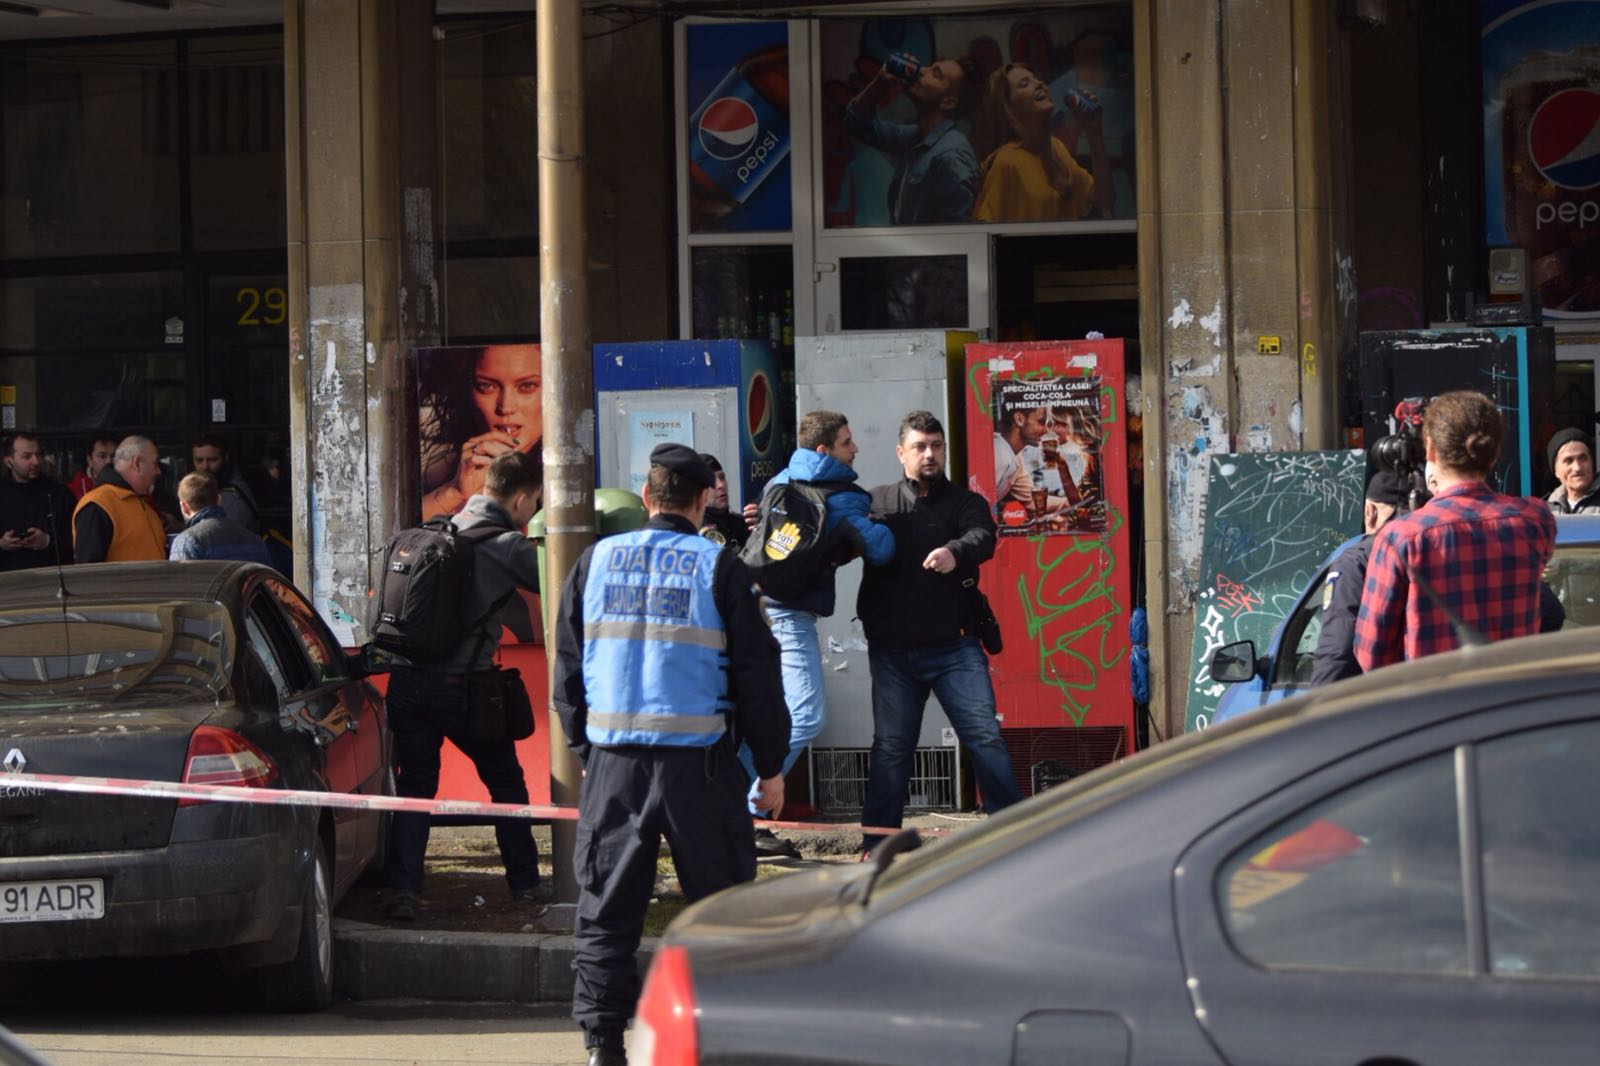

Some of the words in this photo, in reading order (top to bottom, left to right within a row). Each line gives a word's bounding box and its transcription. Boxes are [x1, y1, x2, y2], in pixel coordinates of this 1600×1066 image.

[736, 130, 779, 183] pepsi
[236, 288, 287, 326] 29
[1003, 383, 1063, 393] SPECIALITATEA
[1023, 391, 1071, 400] COCA-COLA
[751, 460, 774, 481] peps
